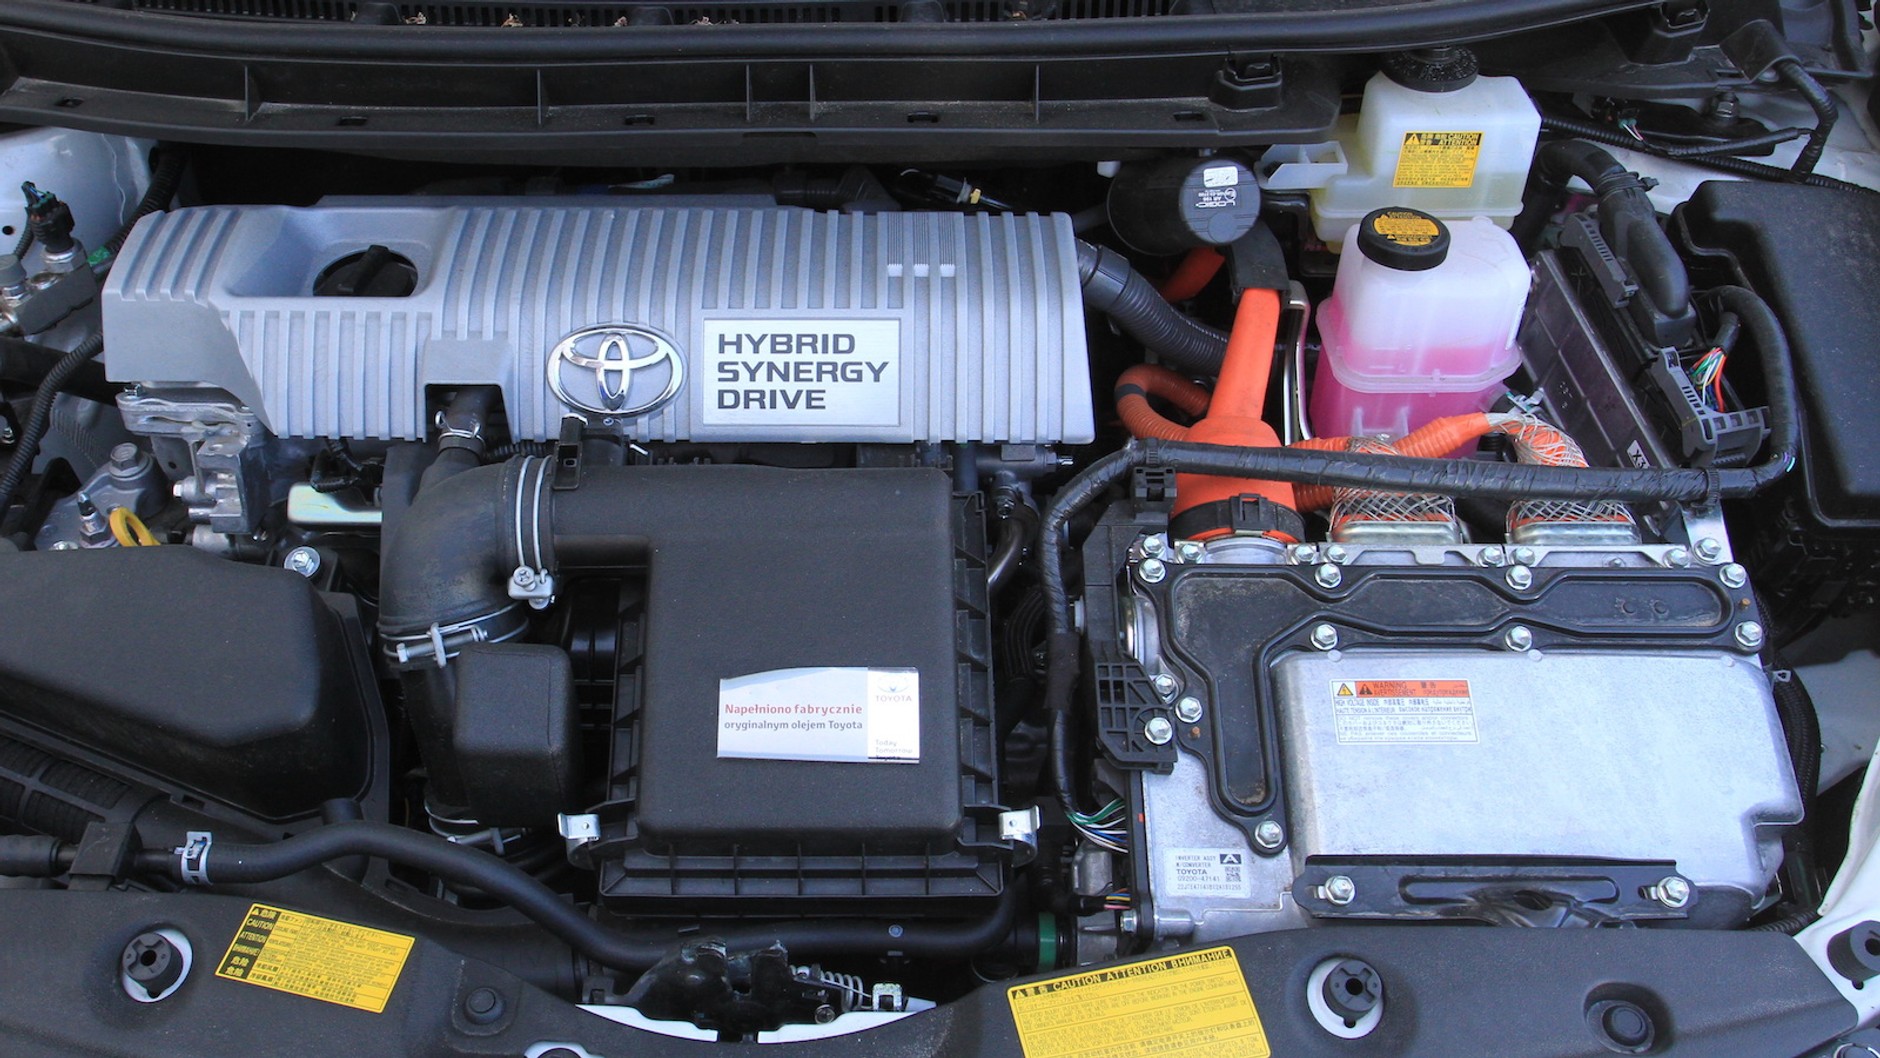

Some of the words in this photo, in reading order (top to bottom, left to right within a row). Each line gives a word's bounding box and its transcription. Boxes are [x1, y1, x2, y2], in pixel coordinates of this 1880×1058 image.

[718, 333, 855, 354] HYBRID
[717, 361, 889, 382] SYNERGY
[717, 389, 826, 409] DRIVE
[1373, 681, 1407, 689] WARNING
[725, 704, 791, 716] Napełniono
[794, 704, 862, 716] fabrycznie
[724, 720, 789, 731] oryginalnym
[791, 720, 825, 731] olejem
[828, 720, 863, 731] Toyota
[876, 739, 897, 747] Today
[876, 746, 912, 754] Tomorrow
[246, 918, 274, 930] CAUTION
[239, 931, 268, 943] ATTENTION
[1053, 974, 1101, 991] CAUTION
[1106, 962, 1167, 981] ATTENTION
[1172, 950, 1230, 968] ВНИМАНИЕ
